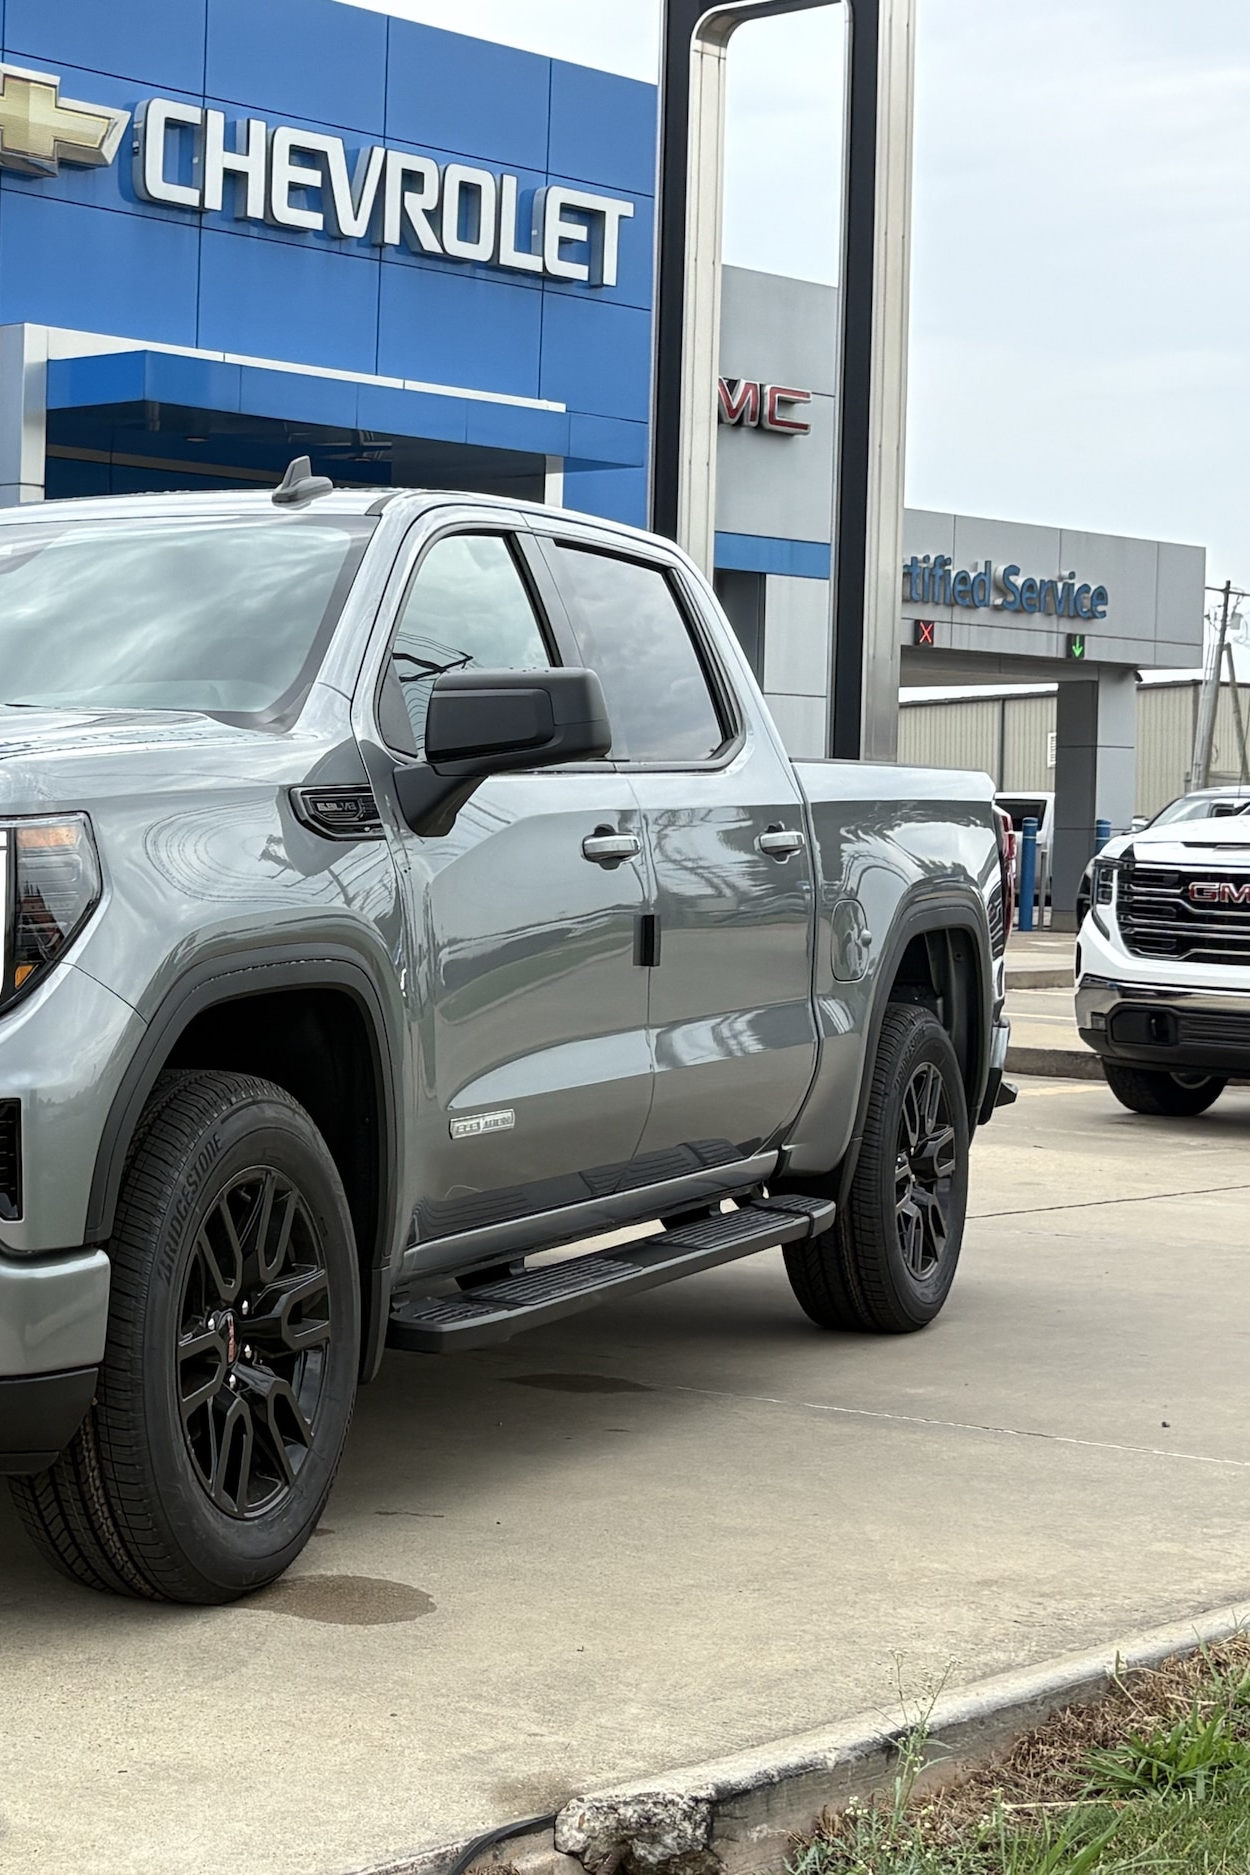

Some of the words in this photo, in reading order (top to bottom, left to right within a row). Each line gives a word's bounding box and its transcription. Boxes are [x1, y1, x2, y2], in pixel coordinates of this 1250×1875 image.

[135, 97, 634, 287] CHEVROLET
[1000, 564, 1109, 620] Service
[157, 1131, 223, 1287] BRIDGESTONE
